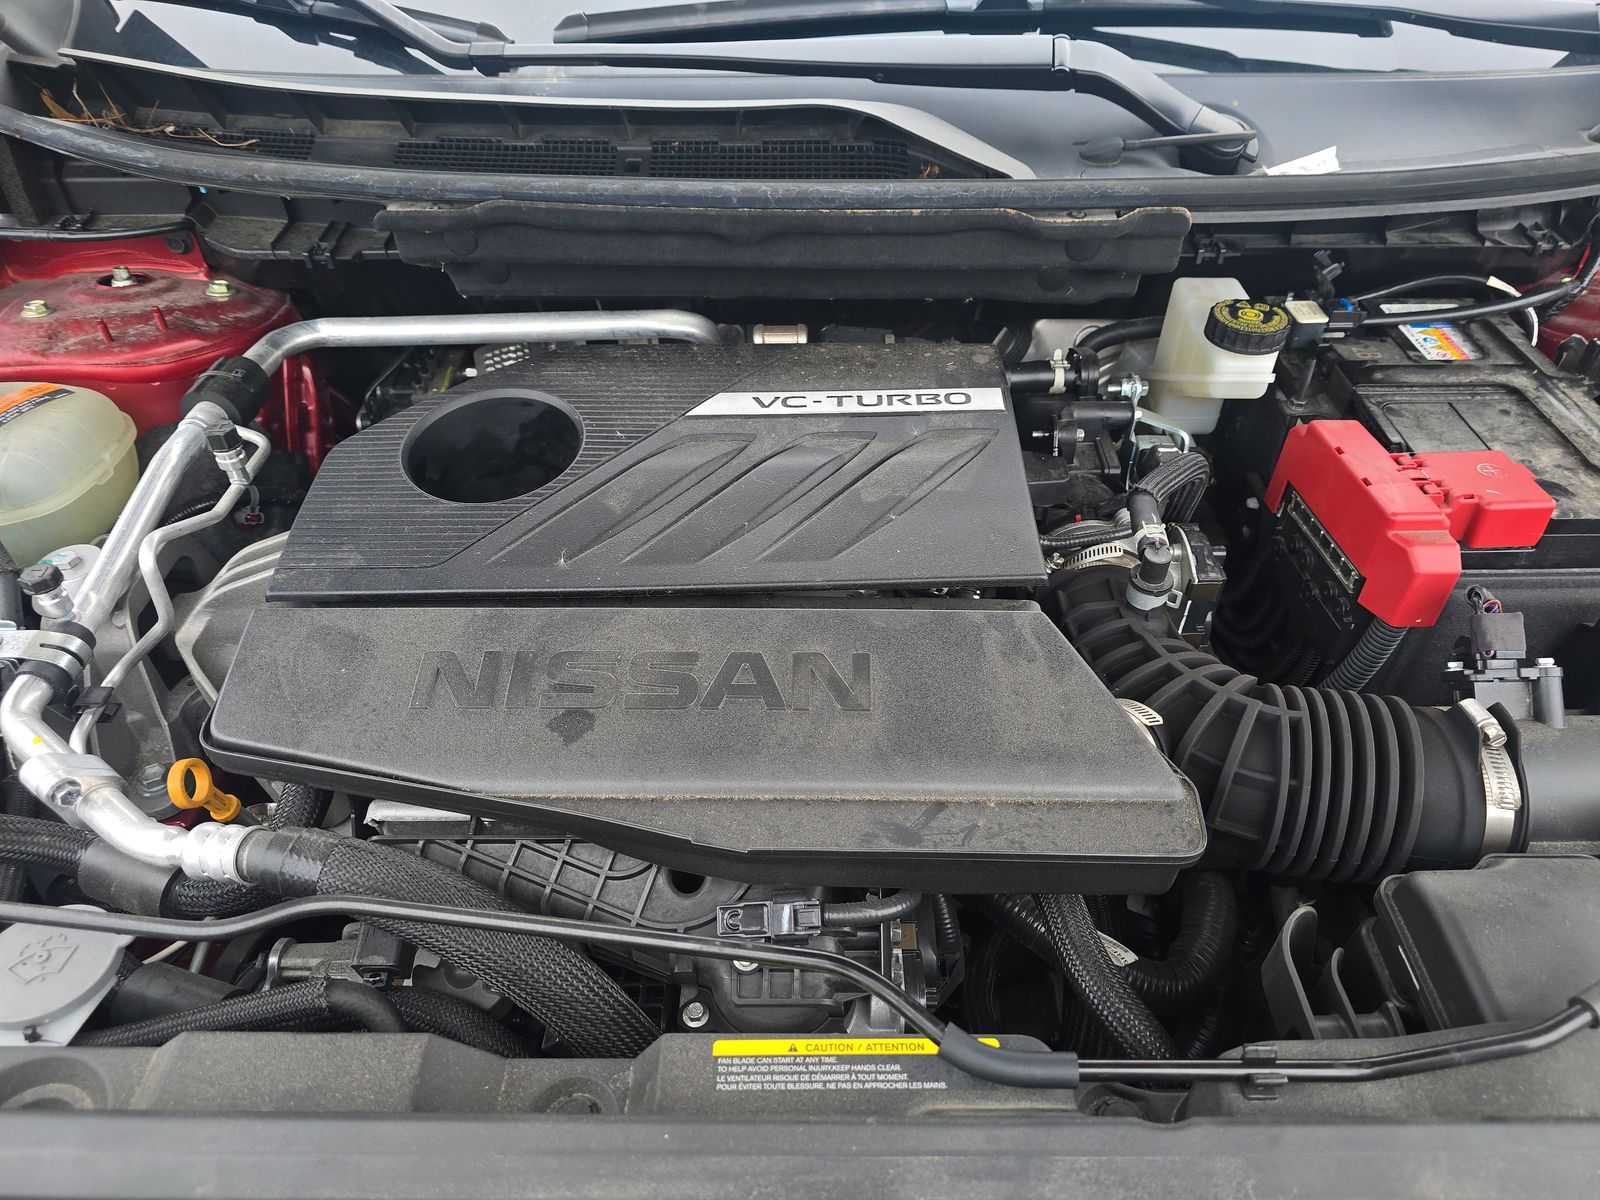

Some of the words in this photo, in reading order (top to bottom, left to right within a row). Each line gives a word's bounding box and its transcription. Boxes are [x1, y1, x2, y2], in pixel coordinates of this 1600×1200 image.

[752, 392, 972, 408] VC-TURBO
[409, 650, 872, 711] NISSAN
[805, 1043, 854, 1052] CAUTION
[866, 1042, 925, 1052] ATTENTION
[772, 1074, 799, 1082] RISQUE
[811, 1072, 849, 1081] DÉMARRER
[738, 1081, 762, 1090] ÉVITER
